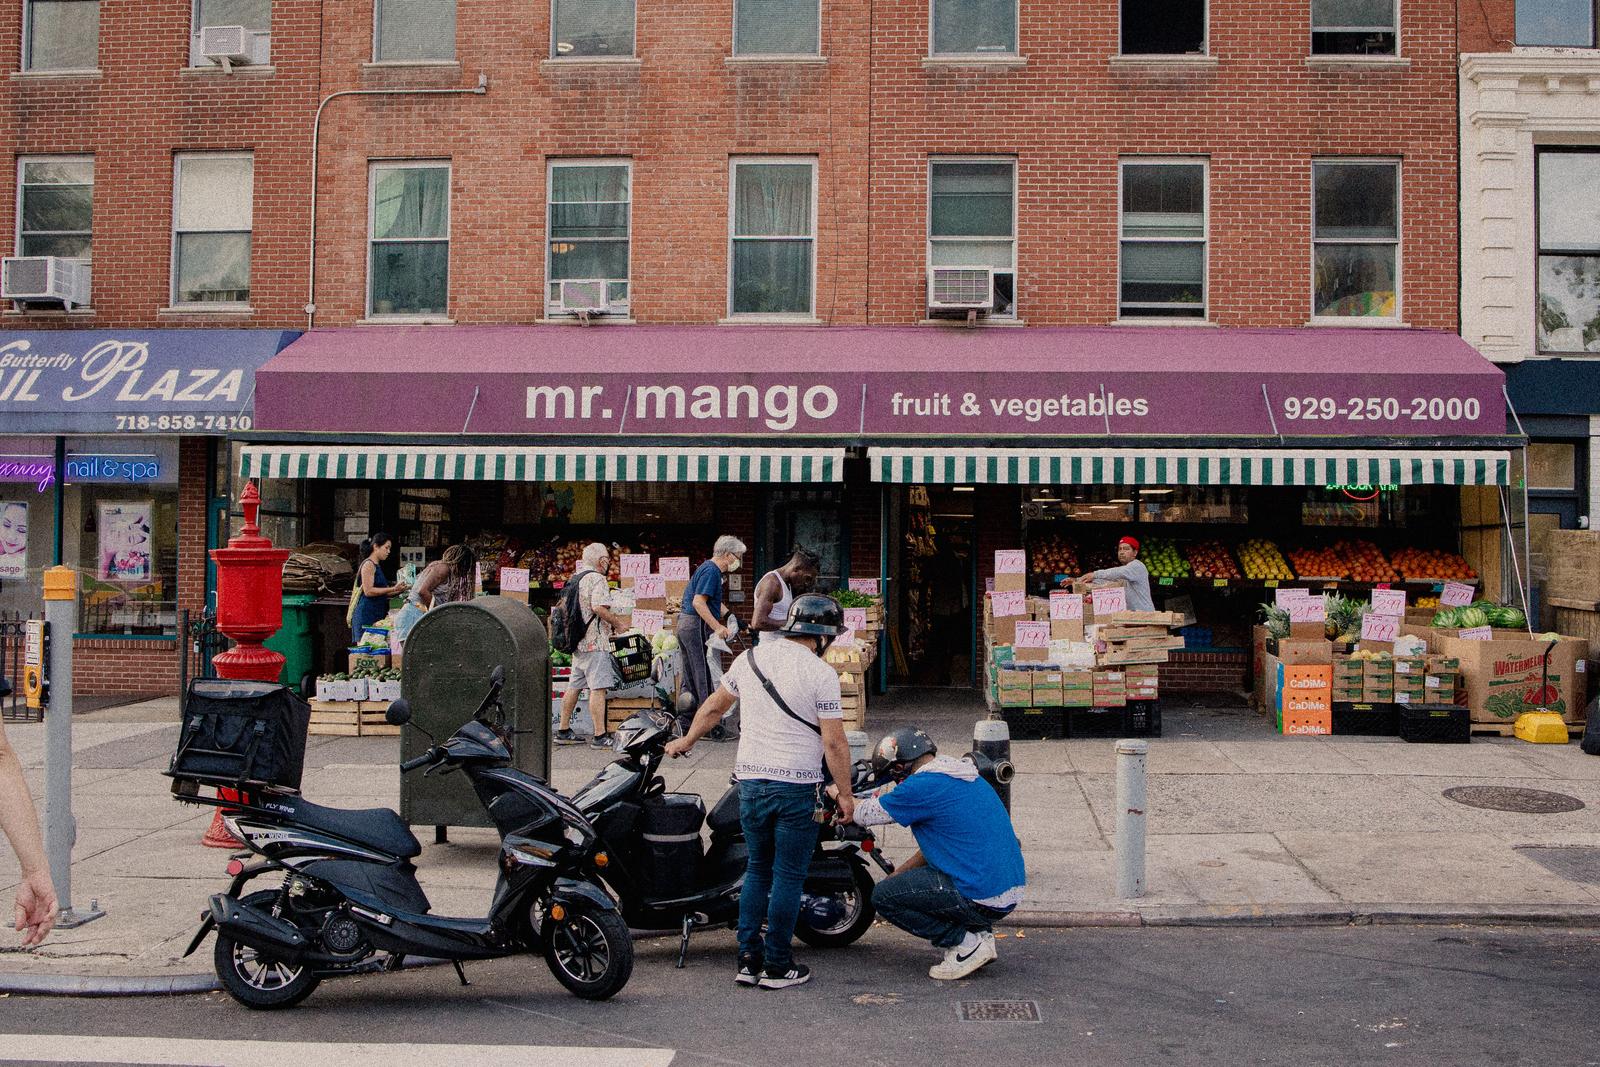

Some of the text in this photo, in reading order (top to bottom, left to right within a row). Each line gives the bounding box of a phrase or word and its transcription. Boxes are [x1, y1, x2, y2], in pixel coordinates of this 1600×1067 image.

[0, 352, 77, 371] Butterfly
[62, 339, 244, 402] PLAZA
[525, 384, 839, 432] mr. mango
[890, 392, 1150, 423] fruit & vegetables
[1283, 396, 1481, 421] 929-250-2000
[115, 414, 252, 431] 718-858-7410
[67, 457, 158, 482] nail & spa
